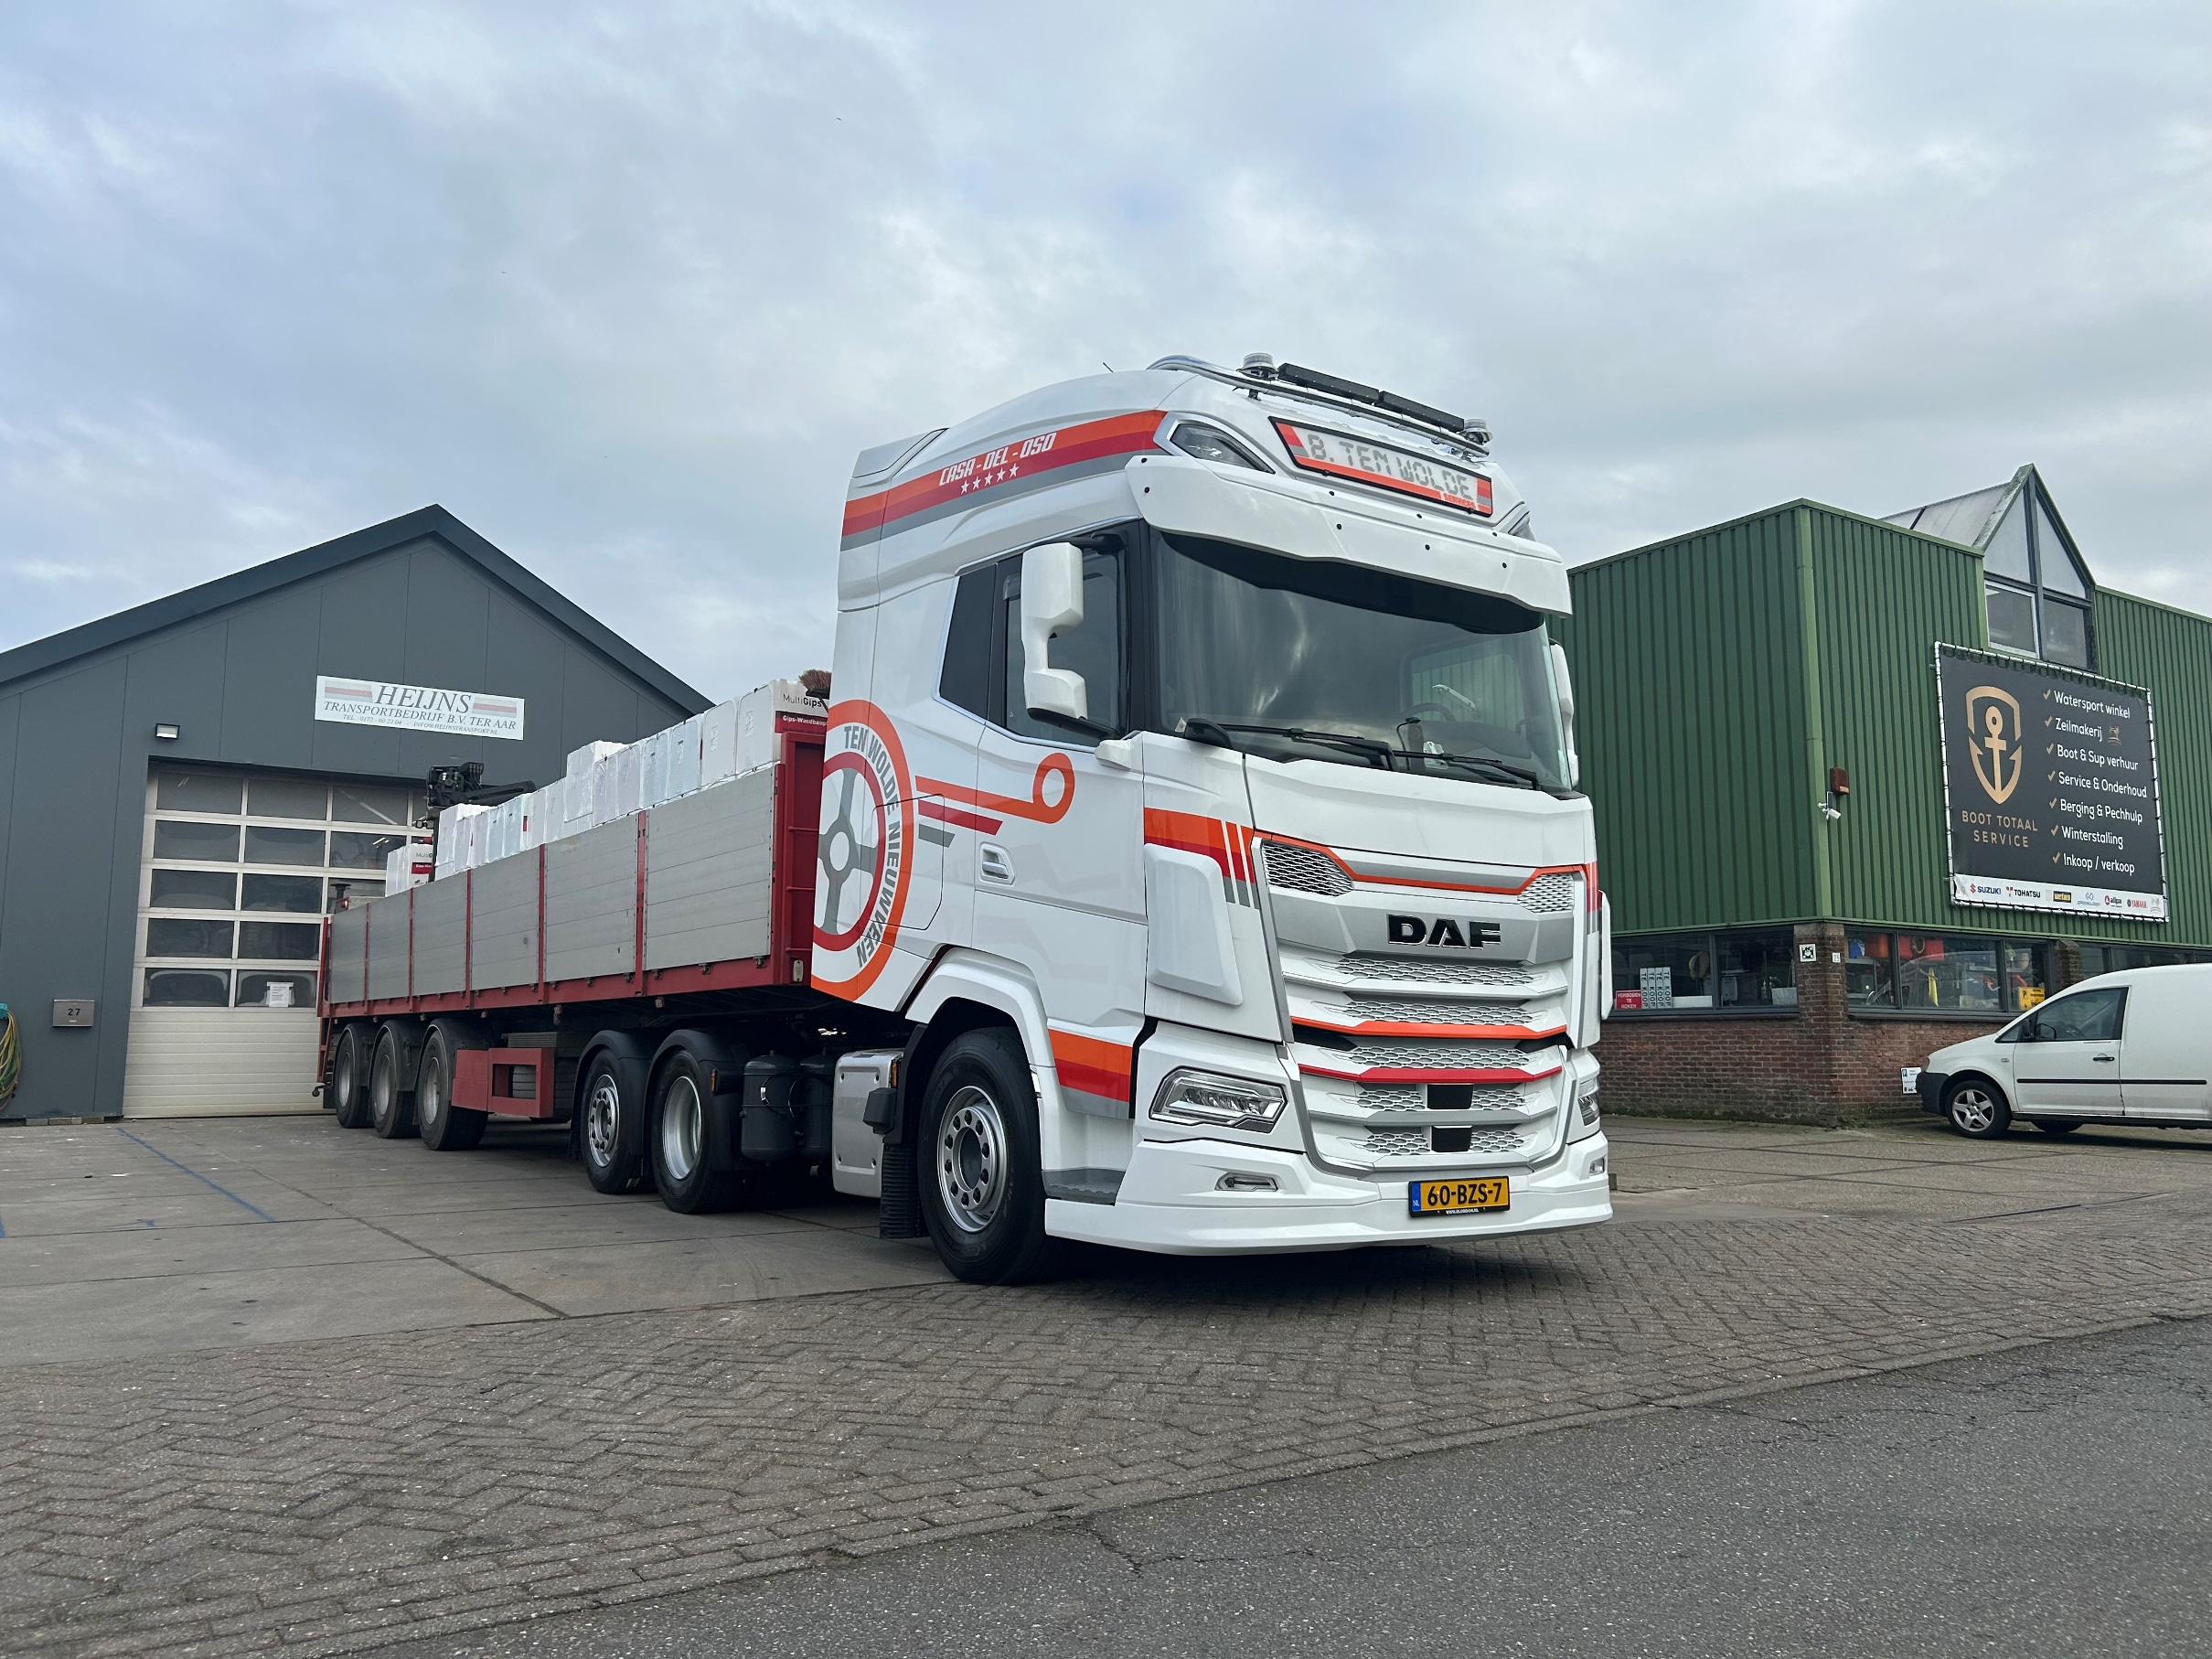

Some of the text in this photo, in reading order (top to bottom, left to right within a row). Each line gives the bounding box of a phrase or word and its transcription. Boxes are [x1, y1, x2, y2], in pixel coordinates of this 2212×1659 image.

[1339, 441, 1392, 476] TEN
[1396, 456, 1474, 500] WOLDE
[375, 685, 472, 713] HEIJNS
[783, 693, 822, 708] MultiGips
[2054, 690, 2131, 719] Watersport winkel
[324, 701, 517, 730] TRANSPORTBEDRIJF B.V. TER AAR
[2055, 718, 2102, 742] Zeilmakerij
[2057, 744, 2139, 771] Boot & Sup verhuur
[844, 725, 869, 752] TEN
[868, 734, 900, 816] WOLDE
[2058, 771, 2147, 798] Service & Onderhoud
[1961, 810, 2038, 831] BOOT TOTAAL
[2060, 798, 2143, 826] Berging & Pechhulp
[1973, 830, 2029, 848] SERVICE
[2061, 825, 2124, 851] Winterstalling
[2063, 852, 2135, 876] Inkoop / verkoop
[1977, 886, 2001, 894] SUZUKI
[2014, 889, 2041, 898] TOHATSU
[1386, 914, 1501, 950] DAF
[1641, 972, 1646, 981] TE
[1649, 972, 1654, 980] TE
[1657, 972, 1662, 980] TE
[1664, 971, 1669, 979] TE
[68, 1008, 80, 1016] 27
[1427, 1183, 1501, 1206] 60-BZS-7
